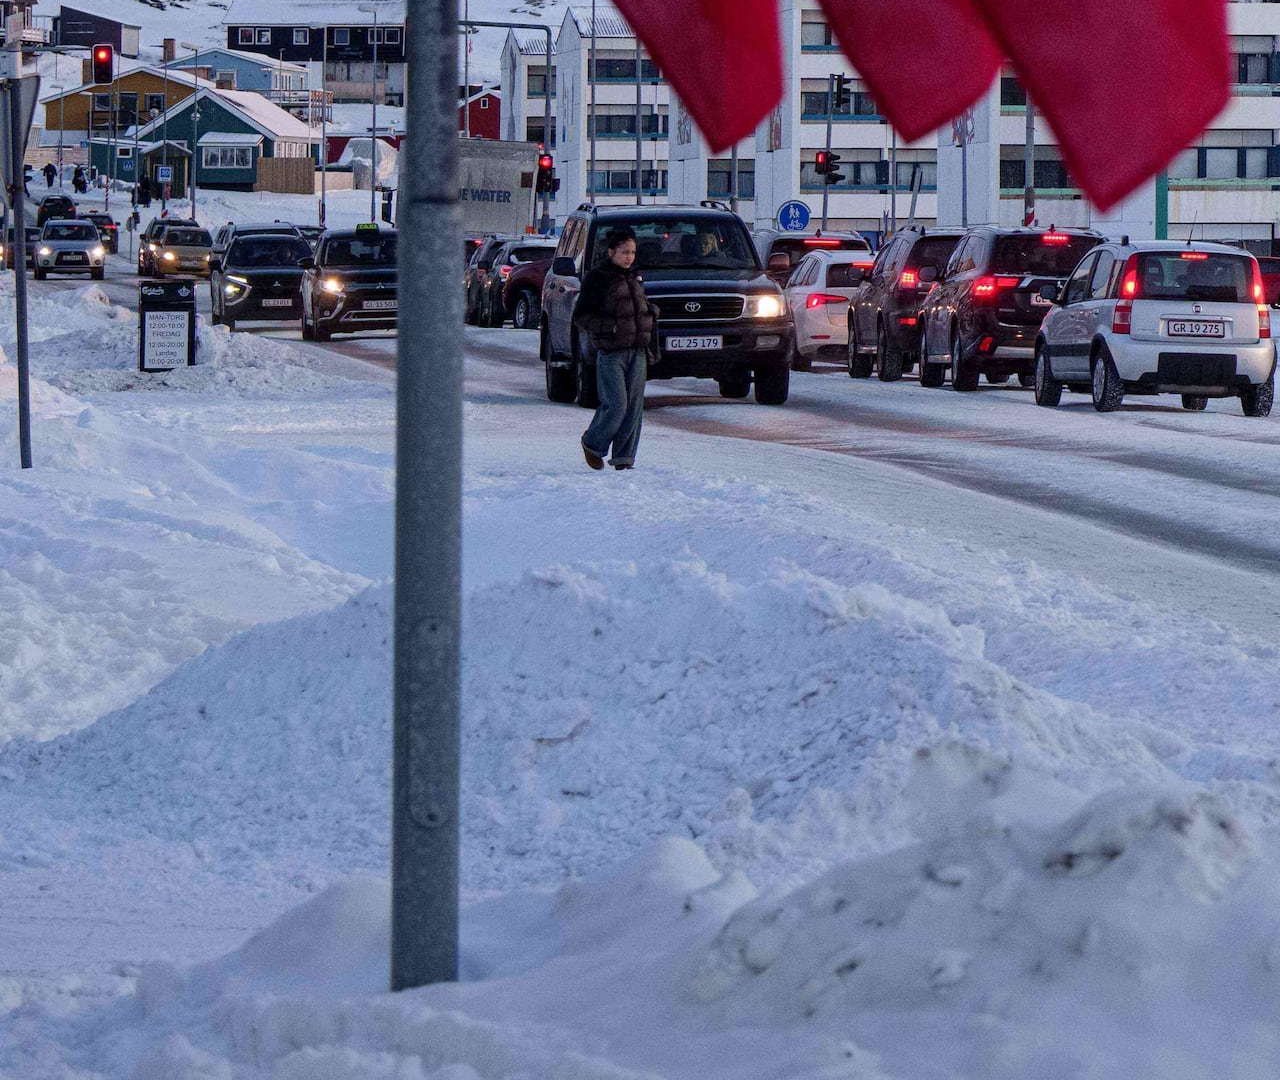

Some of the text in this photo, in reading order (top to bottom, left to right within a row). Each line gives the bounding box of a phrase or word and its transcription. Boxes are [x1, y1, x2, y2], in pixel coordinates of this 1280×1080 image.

[470, 189, 512, 203] WATER
[1173, 323, 1220, 334] GR 19 275
[671, 338, 718, 348] GL 25 179
